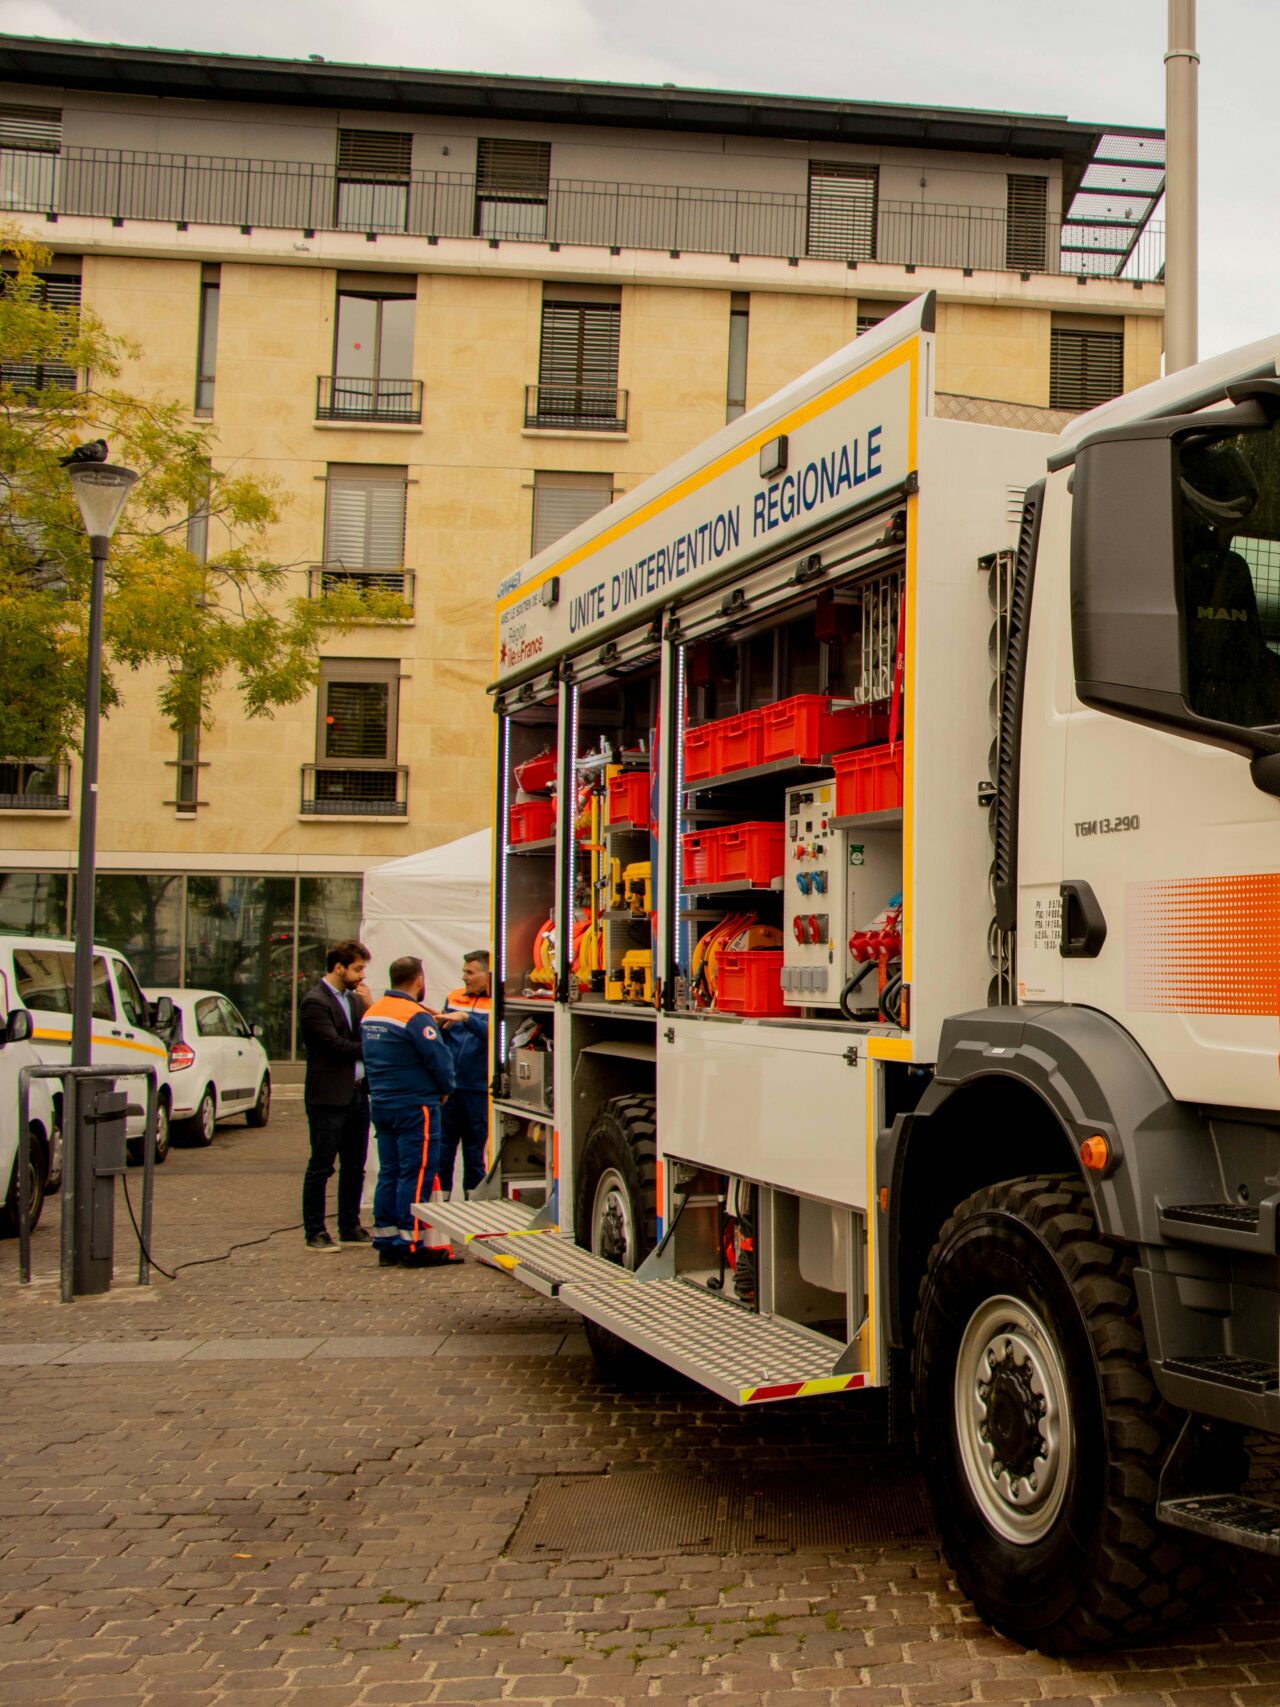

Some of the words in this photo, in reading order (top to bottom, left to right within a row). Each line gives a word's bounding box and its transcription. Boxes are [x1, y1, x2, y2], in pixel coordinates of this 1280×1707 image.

[569, 582, 605, 634] UNITE
[612, 505, 740, 612] D'INTERVENTION
[753, 425, 882, 538] REGIONALE
[1197, 606, 1248, 622] MAN
[1074, 820, 1097, 837] TGM
[1099, 815, 1140, 834] 13.290
